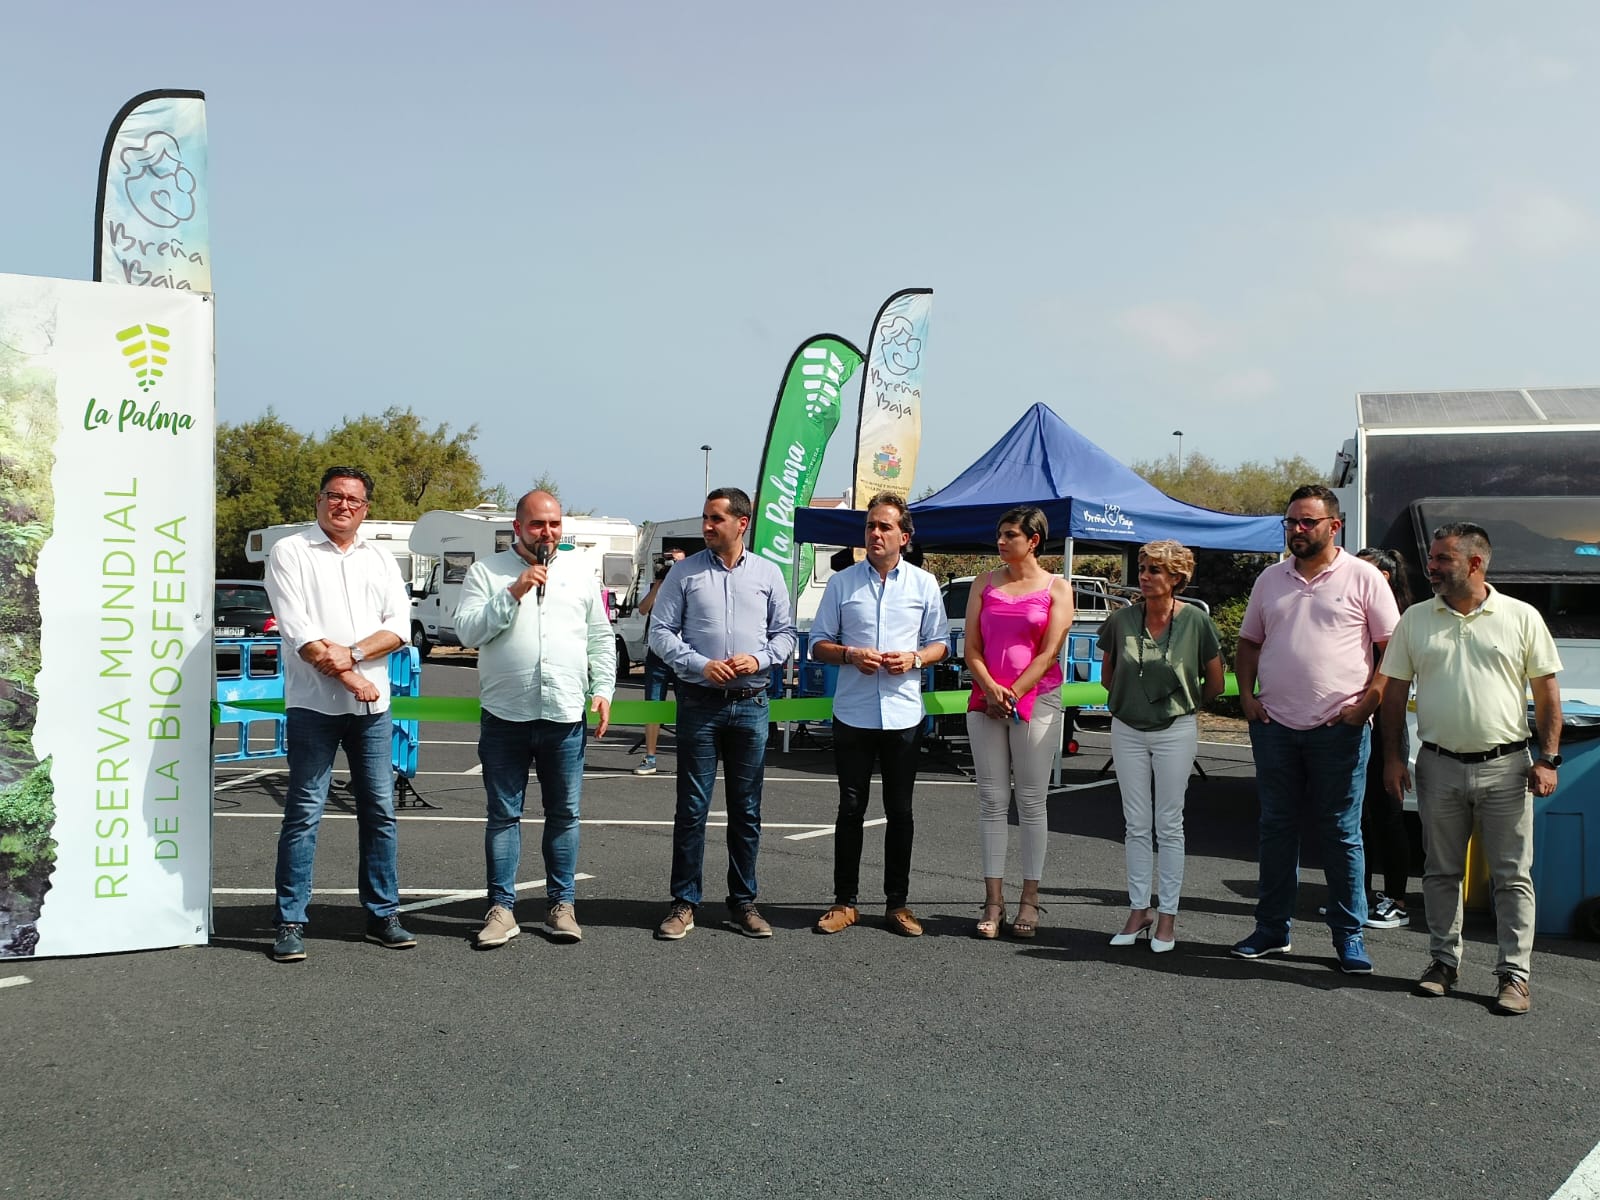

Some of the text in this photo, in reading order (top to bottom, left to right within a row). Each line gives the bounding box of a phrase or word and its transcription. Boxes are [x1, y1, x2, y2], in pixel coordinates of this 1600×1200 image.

[109, 220, 204, 266] Breña
[871, 367, 920, 399] Breña
[876, 391, 912, 420] Baja
[84, 398, 196, 435] La Palma
[761, 440, 807, 565] La Palma
[95, 477, 138, 899] RESERVA MUNDIAL
[148, 515, 187, 860] DE LA BIOSFERA
